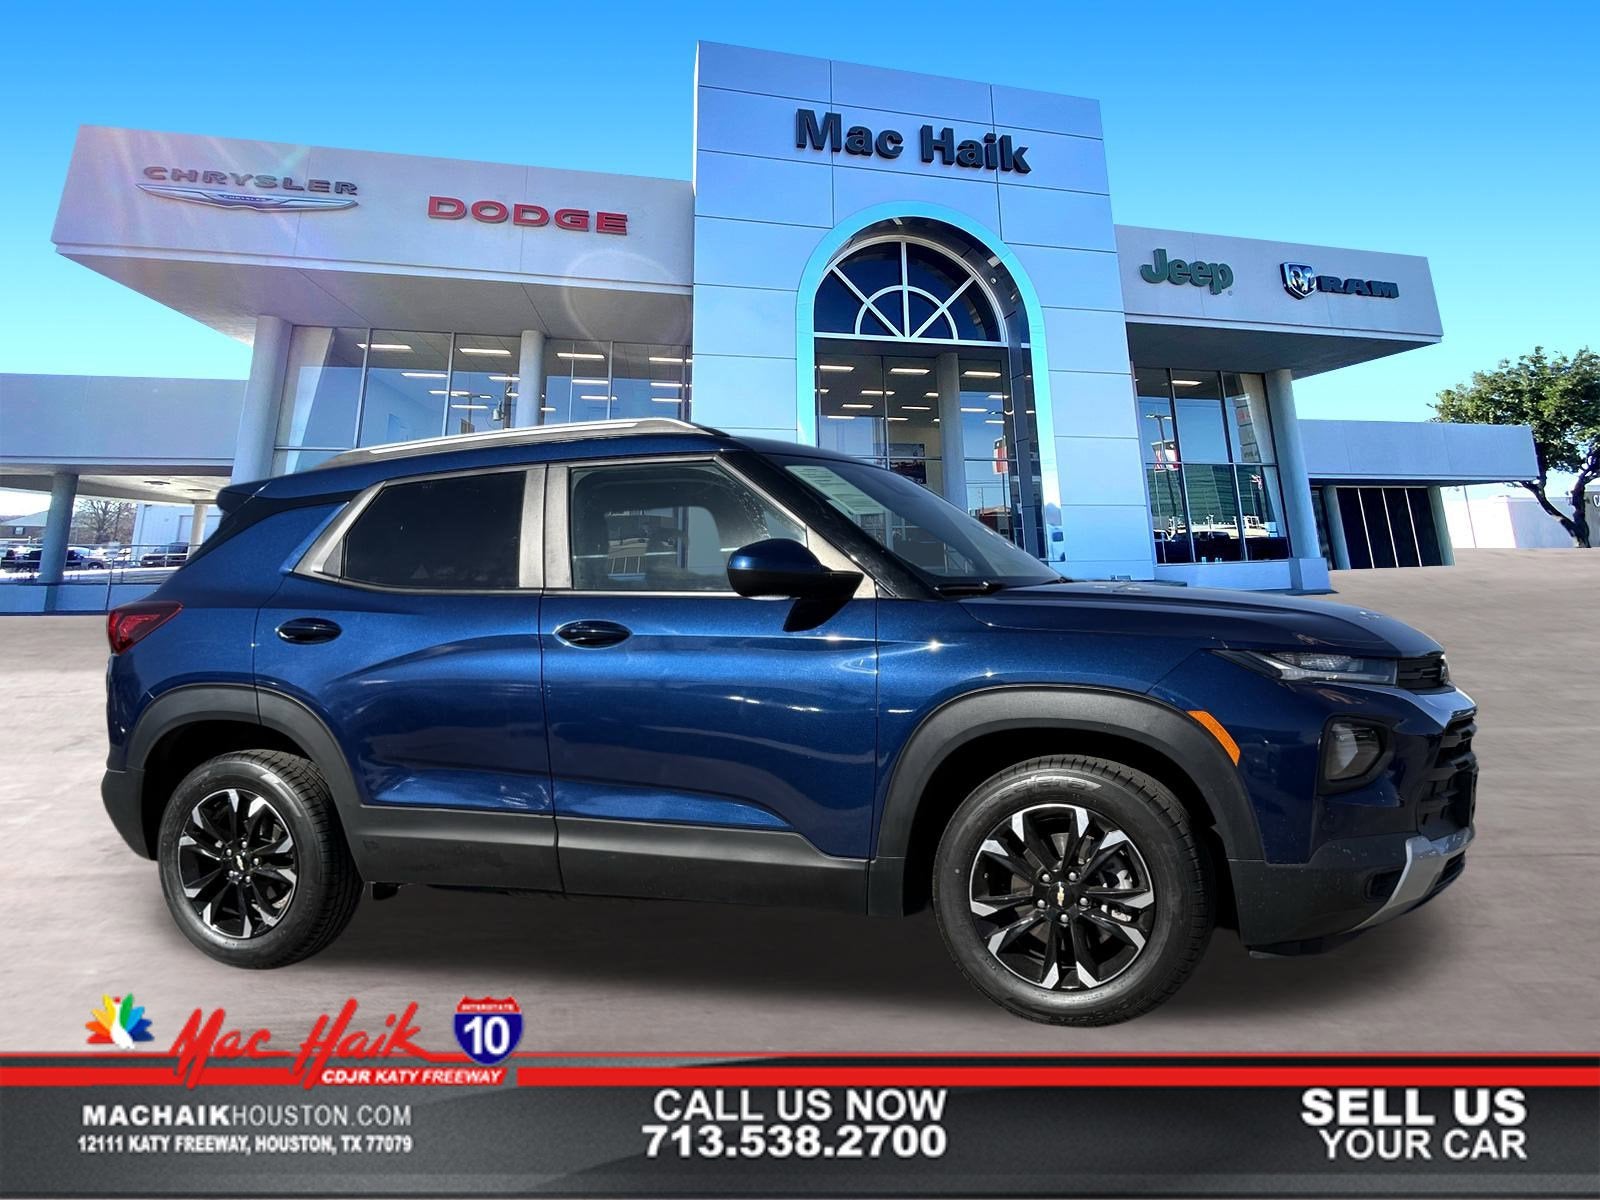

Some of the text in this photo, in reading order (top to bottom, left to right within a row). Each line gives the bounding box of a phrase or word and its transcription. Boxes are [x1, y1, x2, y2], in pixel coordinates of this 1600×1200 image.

[795, 108, 1031, 174] Mac Haik
[143, 166, 358, 196] CHRYSLER
[428, 196, 628, 236] DODGE
[1140, 248, 1234, 295] Jeep
[1316, 275, 1399, 299] RAM
